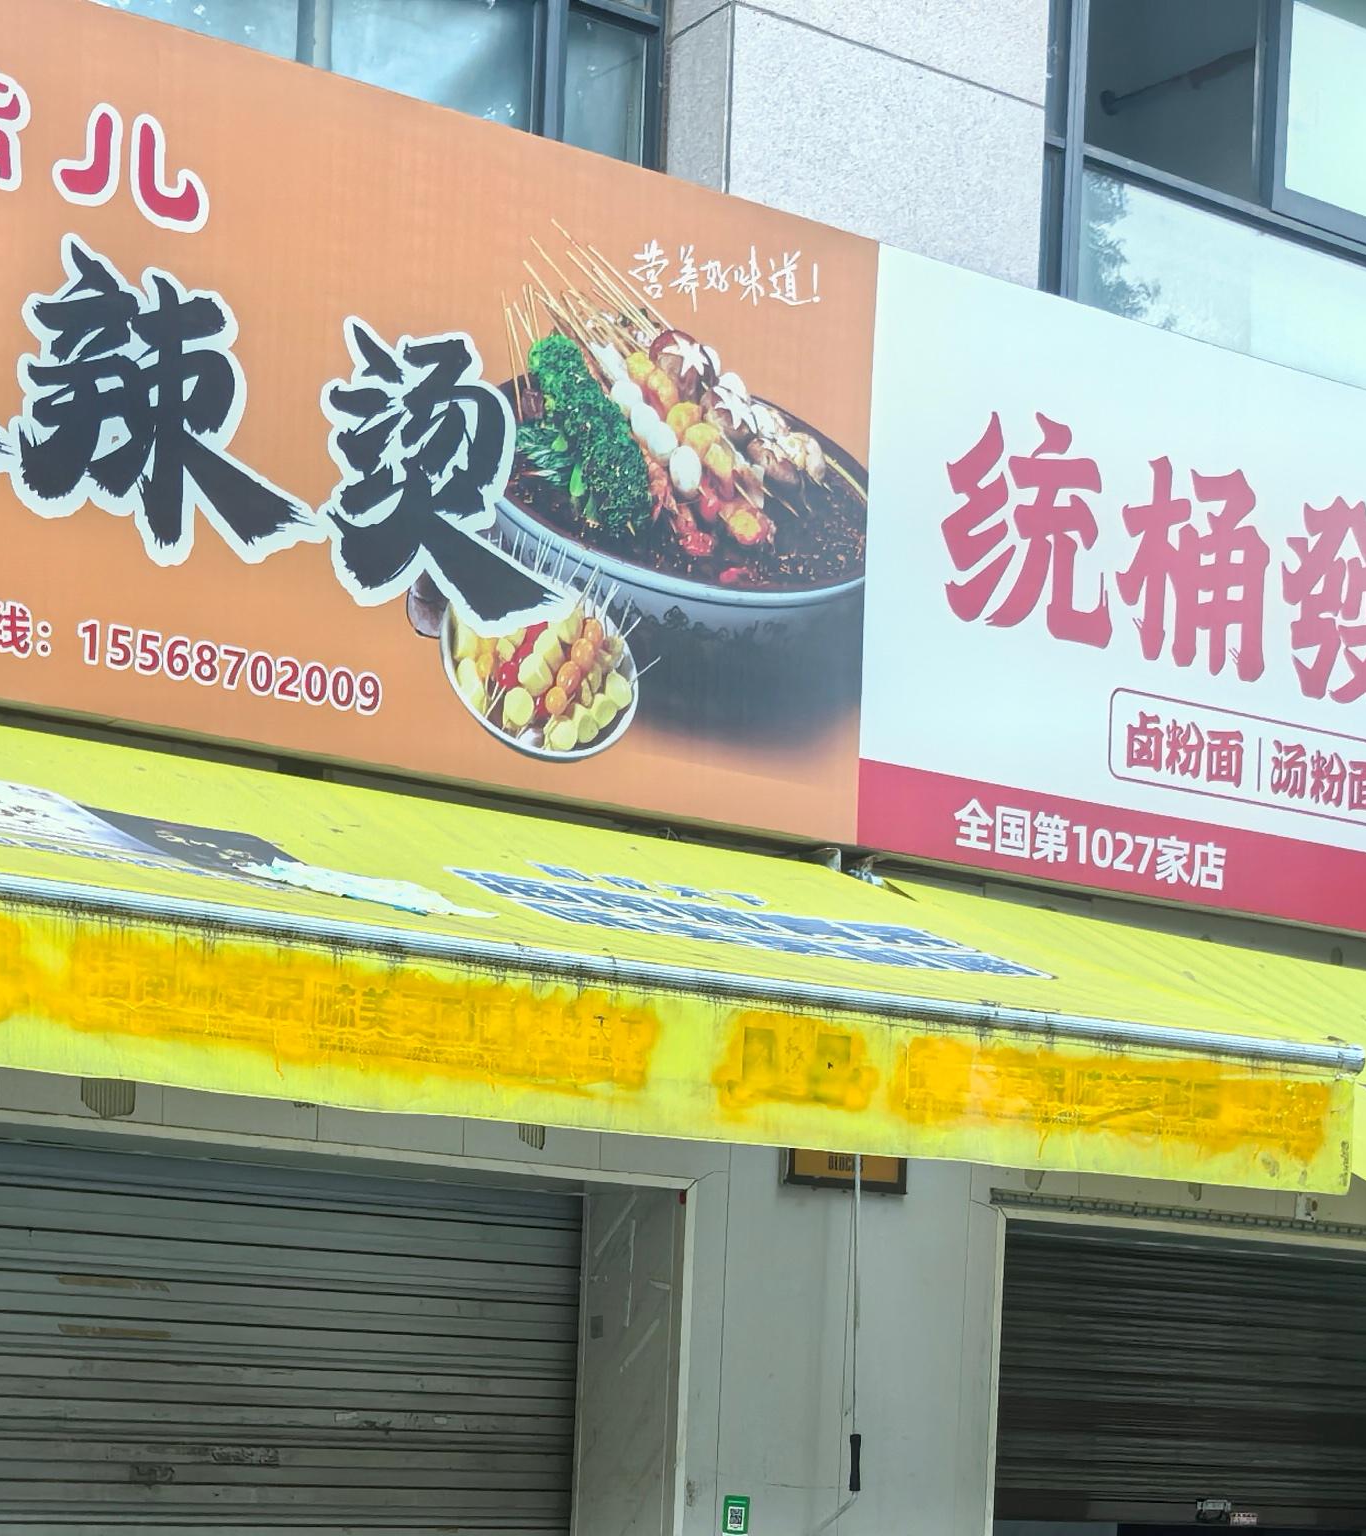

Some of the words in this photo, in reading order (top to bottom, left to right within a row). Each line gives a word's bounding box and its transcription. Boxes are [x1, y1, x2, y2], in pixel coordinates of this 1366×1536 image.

[80, 621, 383, 714] 15568702009
[1125, 711, 1244, 790] 卤粉面
[954, 798, 1227, 892] 全国第1027家店
